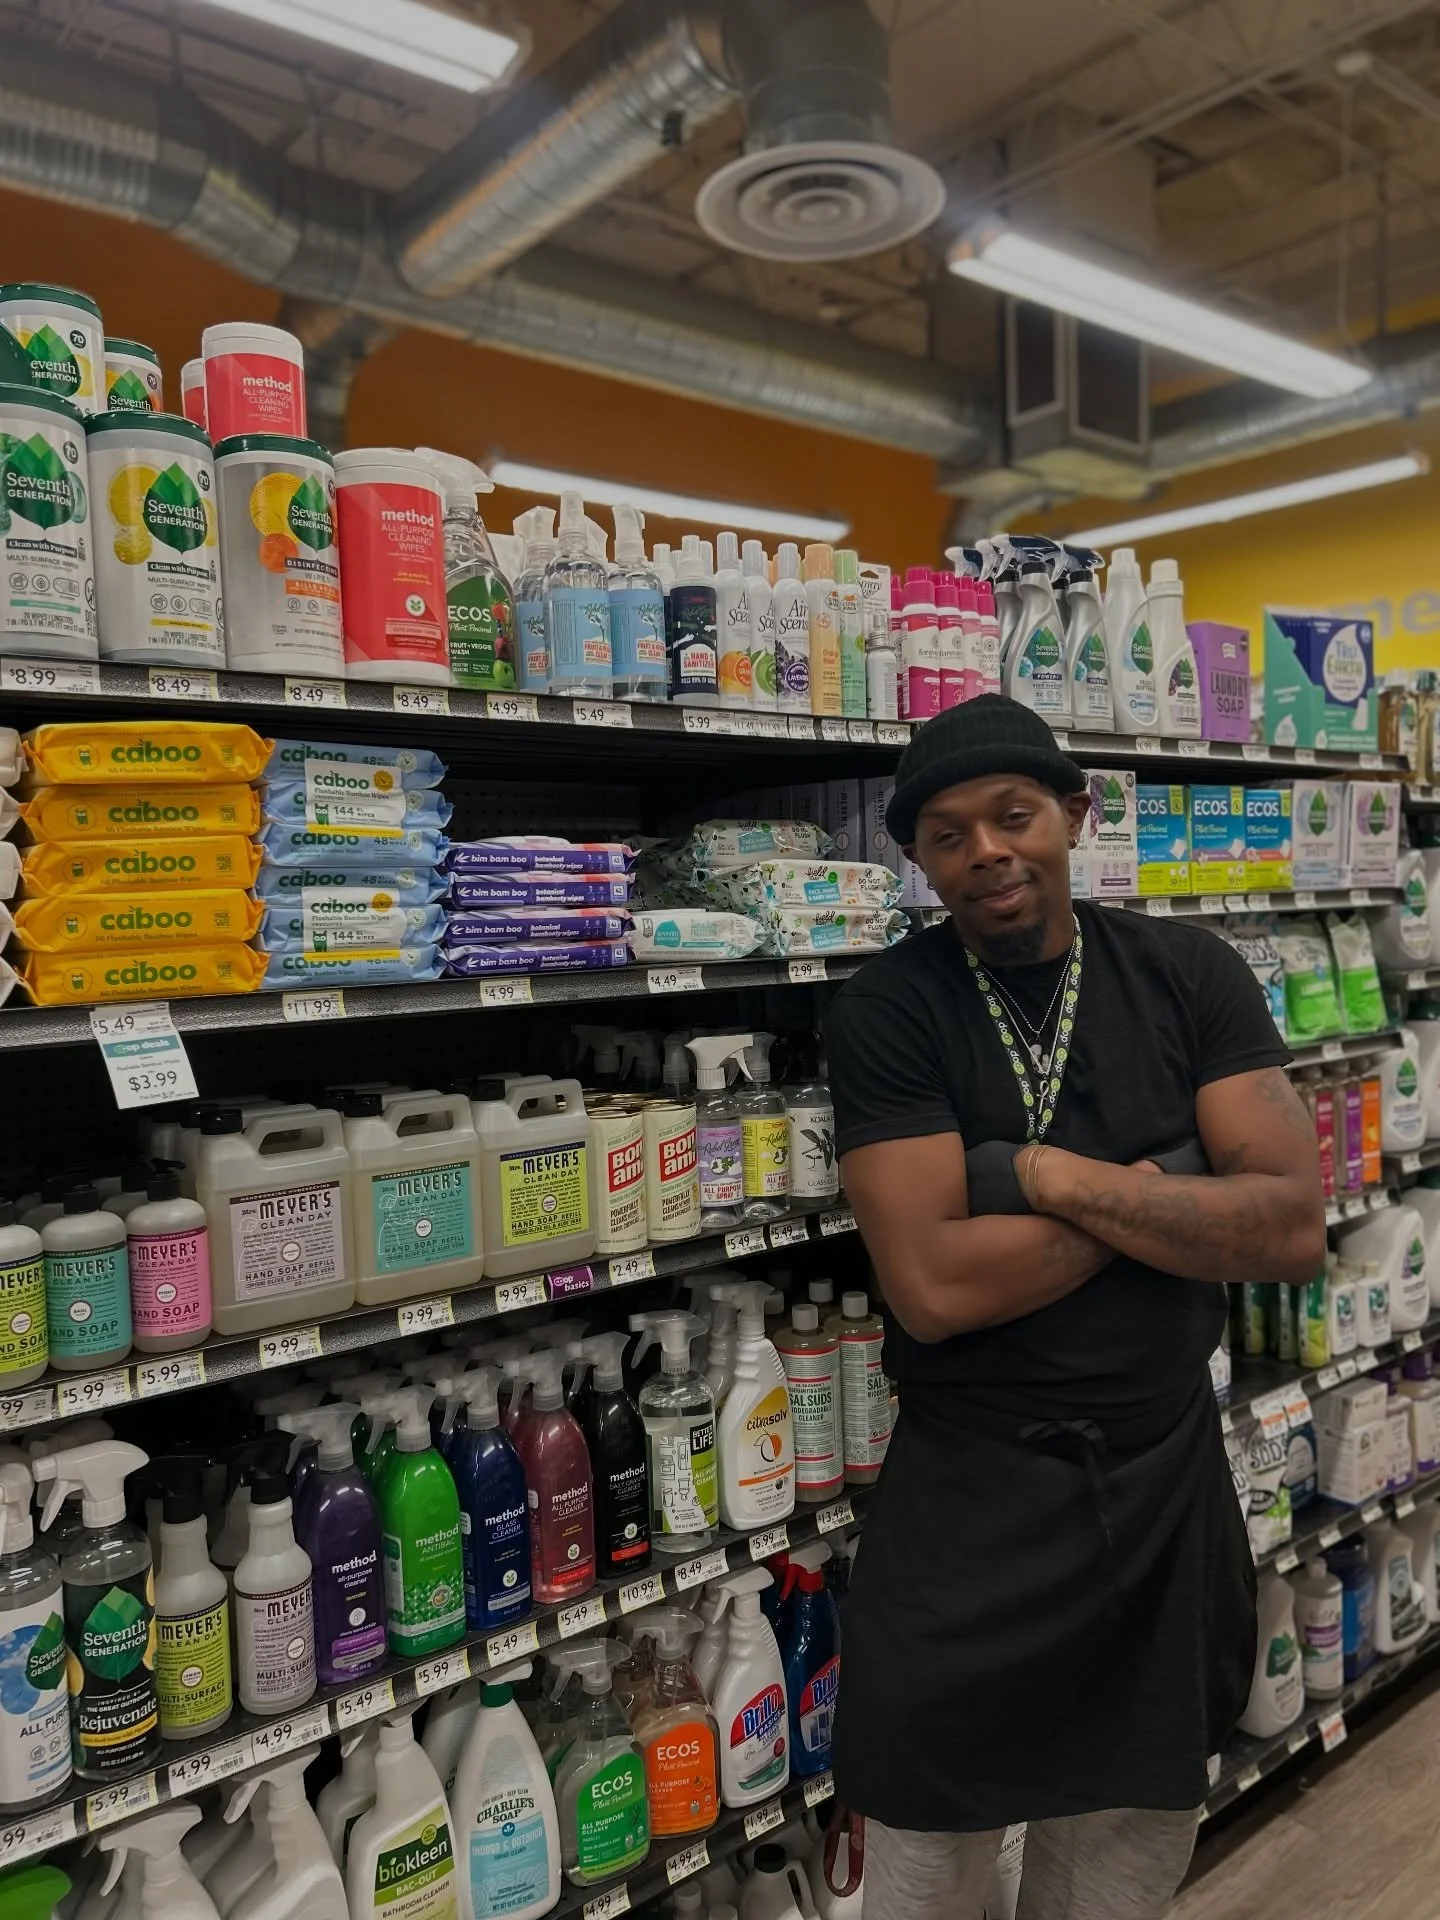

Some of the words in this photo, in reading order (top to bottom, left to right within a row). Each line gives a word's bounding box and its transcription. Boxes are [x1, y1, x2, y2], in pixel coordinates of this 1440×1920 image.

[72, 333, 84, 344] 70
[31, 360, 77, 375] eventh
[243, 376, 292, 392] method
[110, 395, 151, 412] Seventh
[6, 472, 72, 497] Seventh
[8, 490, 72, 507] GENERATION
[148, 498, 205, 521] Seventh
[292, 504, 333, 526] Seventh
[382, 508, 435, 528] method
[149, 514, 206, 532] GENERATION
[292, 518, 333, 535] GENERATION
[389, 533, 432, 547] CLEANING
[448, 606, 492, 622] ECOS
[691, 652, 709, 660] HAND
[10, 668, 56, 686] $8.99
[152, 678, 190, 693] $8.49
[1210, 672, 1248, 698] LAUNDRY
[289, 687, 324, 702] $8.49
[398, 694, 428, 708] $8.49
[489, 702, 518, 716] $4.99
[576, 708, 604, 721] $5.49
[1217, 696, 1245, 714] SOAP
[111, 738, 202, 764] caboo
[314, 771, 370, 790] caboo
[314, 787, 344, 796] Flushable
[346, 790, 370, 798] Bamboo
[108, 799, 200, 823] caboo
[334, 806, 355, 816] 144
[1195, 800, 1228, 816] ECOS
[1247, 801, 1279, 817] ECOS
[105, 849, 196, 874] caboo
[471, 854, 488, 863] bim
[490, 854, 509, 863] bam
[511, 854, 527, 863] boo
[278, 867, 346, 888] caboo
[473, 888, 489, 896] bim
[490, 888, 510, 896] bam
[512, 888, 528, 896] boo
[310, 897, 368, 914] caboo
[100, 904, 193, 931] caboo
[466, 926, 482, 934] bim
[484, 926, 504, 934] bam
[506, 925, 522, 934] boo
[104, 959, 197, 986] caboo
[651, 974, 677, 987] $4.49
[485, 986, 514, 1000] $4.99
[288, 999, 332, 1016] $11.99
[92, 1015, 134, 1035] $5.49
[128, 1070, 177, 1093] $3.99
[810, 1115, 831, 1124] KOALA
[664, 1132, 695, 1160] Bon
[523, 1150, 580, 1175] MEYER'S
[664, 1152, 696, 1176] ami
[398, 1171, 464, 1198] MEYER'S
[524, 1172, 556, 1184] CLEAN
[559, 1168, 580, 1178] DAY
[260, 1191, 333, 1220] MEYER'S
[399, 1195, 438, 1207] CLEAN
[441, 1189, 462, 1199] DAY
[610, 1198, 639, 1220] POWERFULLY
[260, 1216, 304, 1230] CLEAN
[308, 1210, 332, 1222] DAY
[512, 1220, 534, 1230] HAND
[537, 1215, 558, 1225] SOAP
[562, 1210, 582, 1220] REFILL
[138, 1239, 197, 1260] MEYER'S
[728, 1236, 750, 1250] $5.49
[54, 1256, 115, 1278] MEYER'S
[246, 1270, 274, 1282] HAND
[278, 1264, 304, 1276] SOAP
[308, 1259, 334, 1270] REFILL
[613, 1260, 638, 1277] $2.49
[499, 1286, 527, 1303] $9.99
[564, 1280, 590, 1292] basics
[263, 1338, 299, 1358] $9.99
[142, 1363, 180, 1385] $5.99
[63, 1383, 104, 1404] $5.99
[808, 1392, 832, 1406] SUDS
[746, 1408, 788, 1431] citrasolv
[692, 1432, 714, 1450] LIFE
[610, 1462, 646, 1483] method
[552, 1482, 588, 1504] method
[485, 1503, 526, 1527] method
[558, 1502, 585, 1517] CLEANER
[416, 1522, 460, 1549] method
[492, 1523, 522, 1540] CLEANER
[496, 1518, 518, 1533] GLASS
[422, 1538, 456, 1554] ANTIBAC
[752, 1532, 774, 1549] $5.99
[332, 1550, 377, 1575] method
[677, 1560, 702, 1581] $8.49
[622, 1580, 654, 1601] $10.99
[162, 1610, 222, 1642] MEYER'S
[267, 1608, 303, 1626] CLEAN
[561, 1606, 588, 1626] $5.49
[84, 1618, 146, 1646] Seventh
[162, 1637, 200, 1649] CLEAN
[204, 1626, 222, 1642] DAY
[30, 1640, 64, 1666] Seven
[85, 1635, 147, 1657] GENERATION
[489, 1634, 518, 1656] $5.49
[418, 1662, 449, 1683] $5.99
[340, 1692, 373, 1715] $5.49
[742, 1689, 779, 1737] Brillo
[80, 1698, 157, 1734] Rejuvenate
[256, 1724, 292, 1748] $4.99
[656, 1740, 700, 1760] ECOS
[171, 1754, 210, 1781] $4.99
[592, 1771, 633, 1799] ECOS
[90, 1786, 129, 1812] $5.99
[476, 1797, 535, 1824] CHARLIE'S
[492, 1809, 522, 1824] SOAP
[582, 1822, 595, 1832] ALL
[596, 1812, 625, 1828] PURPOSE
[378, 1838, 448, 1884] biokleen
[669, 1851, 692, 1872] $4.99
[396, 1868, 438, 1897] BAC-OUT
[382, 1896, 422, 1919] BATHROOM
[423, 1880, 450, 1903] CLEANER
[584, 1896, 611, 1917] $4.99
